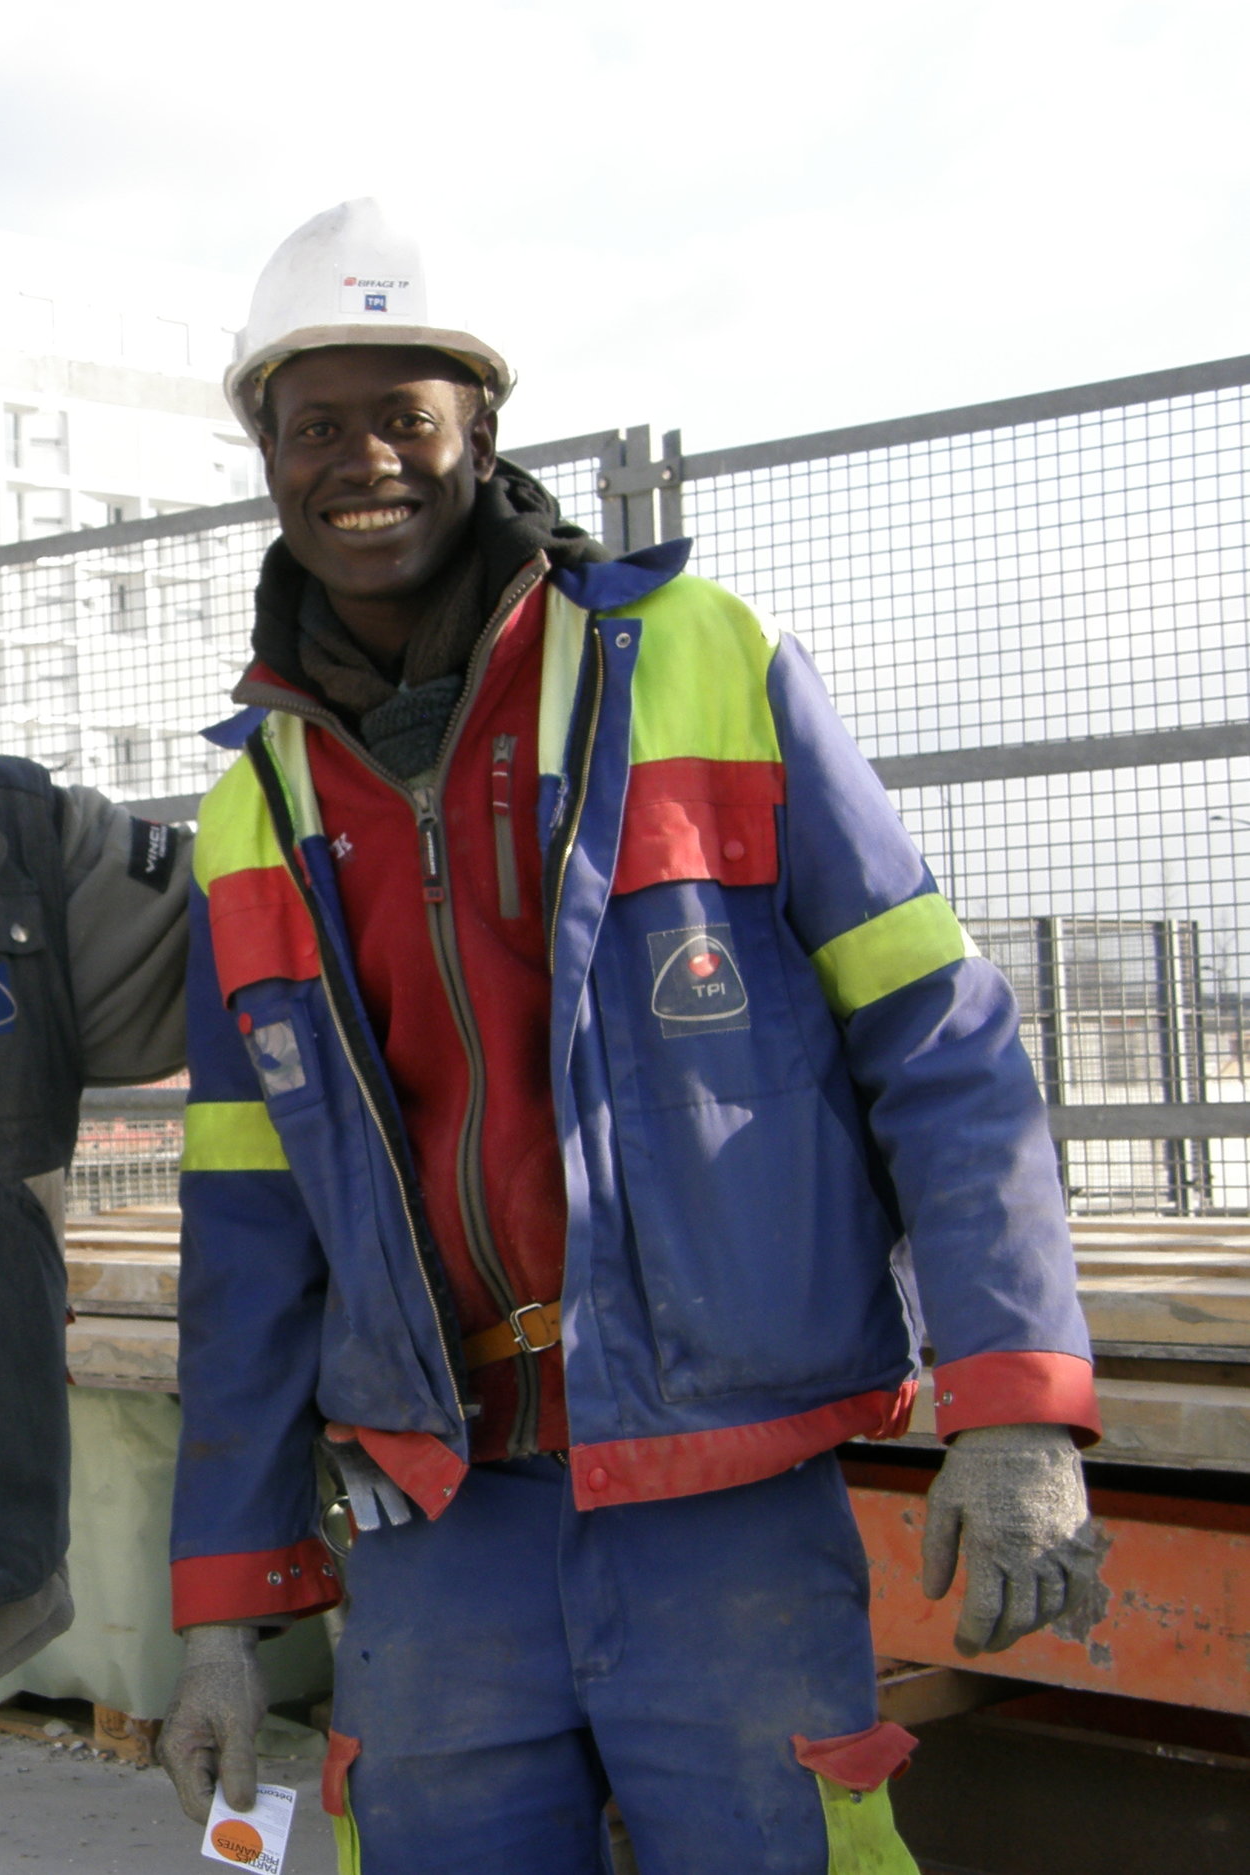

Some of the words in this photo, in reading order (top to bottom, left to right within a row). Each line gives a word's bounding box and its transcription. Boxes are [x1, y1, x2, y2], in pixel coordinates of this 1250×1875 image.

[367, 297, 384, 307] TPI
[145, 825, 161, 873] VINCI
[691, 981, 726, 999] TPI
[216, 1838, 280, 1867] PRENANTES
[236, 1852, 278, 1875] PARTIES
